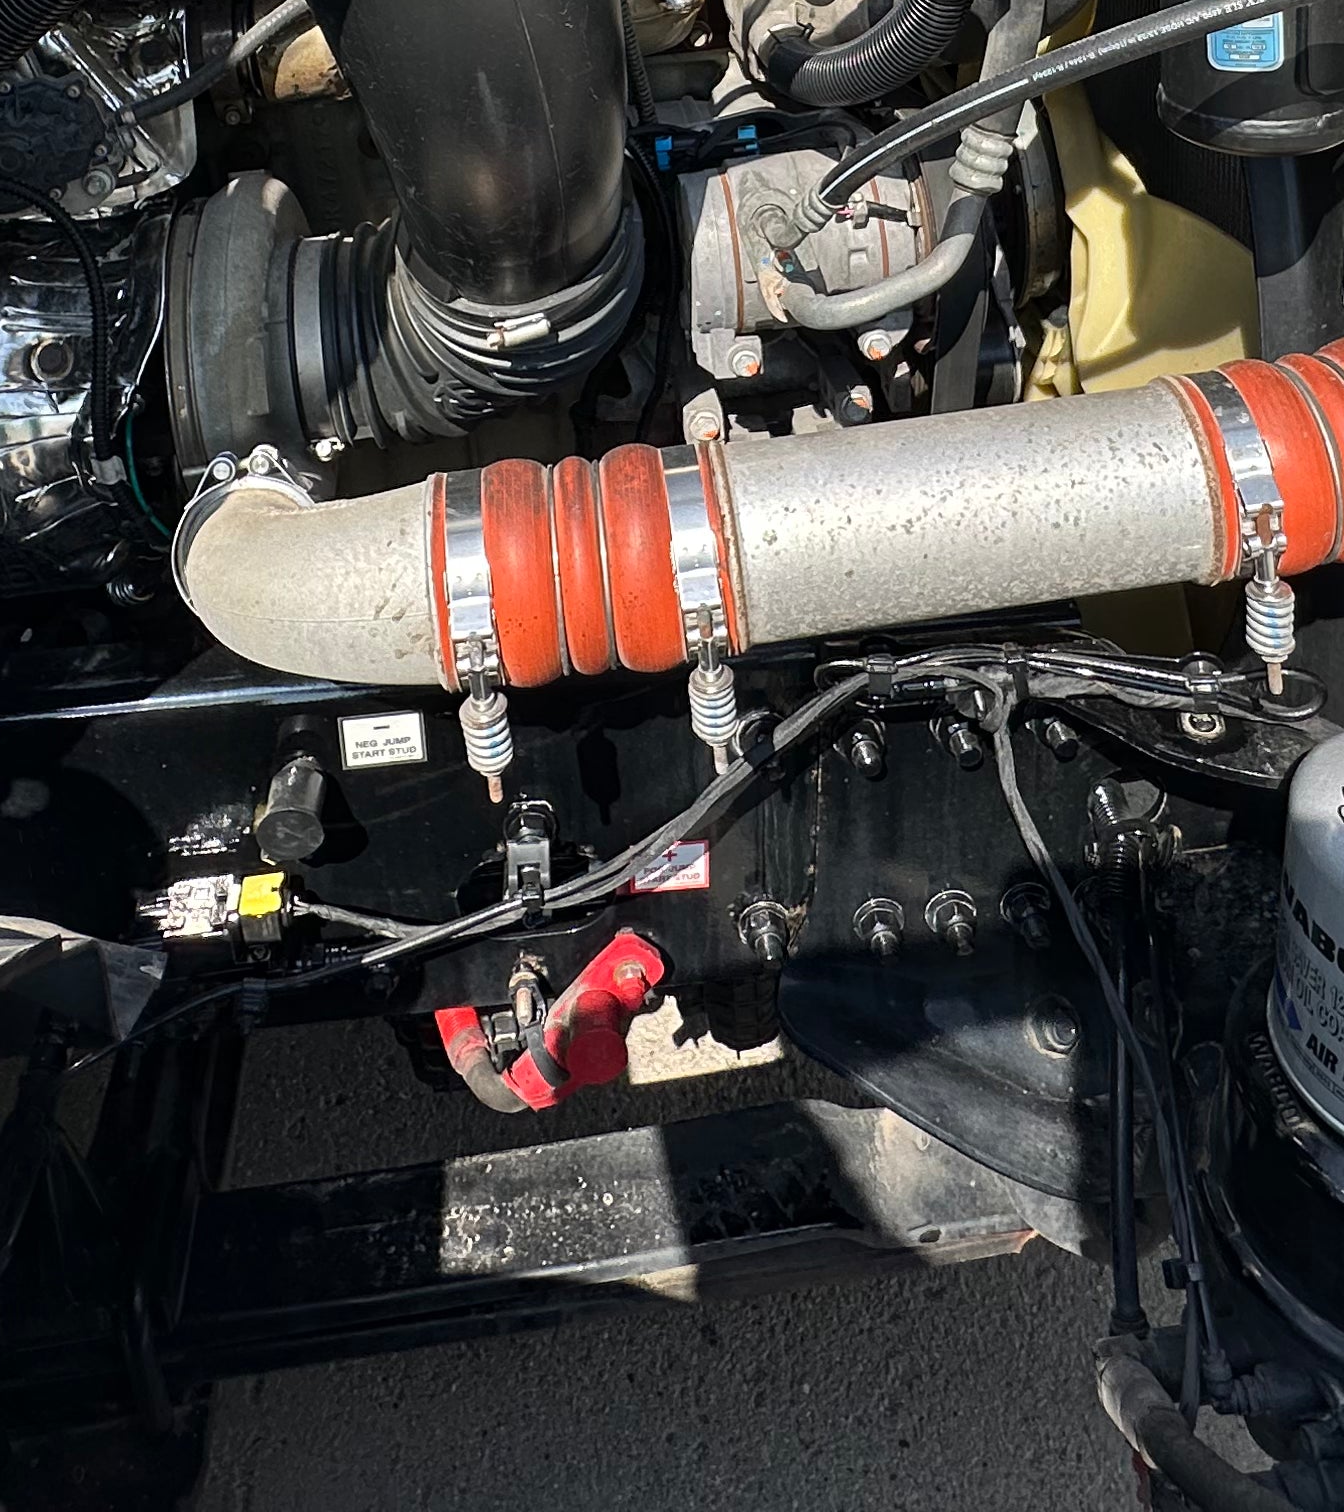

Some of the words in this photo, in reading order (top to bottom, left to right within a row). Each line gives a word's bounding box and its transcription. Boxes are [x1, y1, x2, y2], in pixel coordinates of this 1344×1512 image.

[355, 739, 378, 749] NEG
[383, 736, 411, 747] JUMP
[352, 748, 385, 759] START
[388, 745, 417, 756] STUD
[1306, 1033, 1339, 1075] AIR
